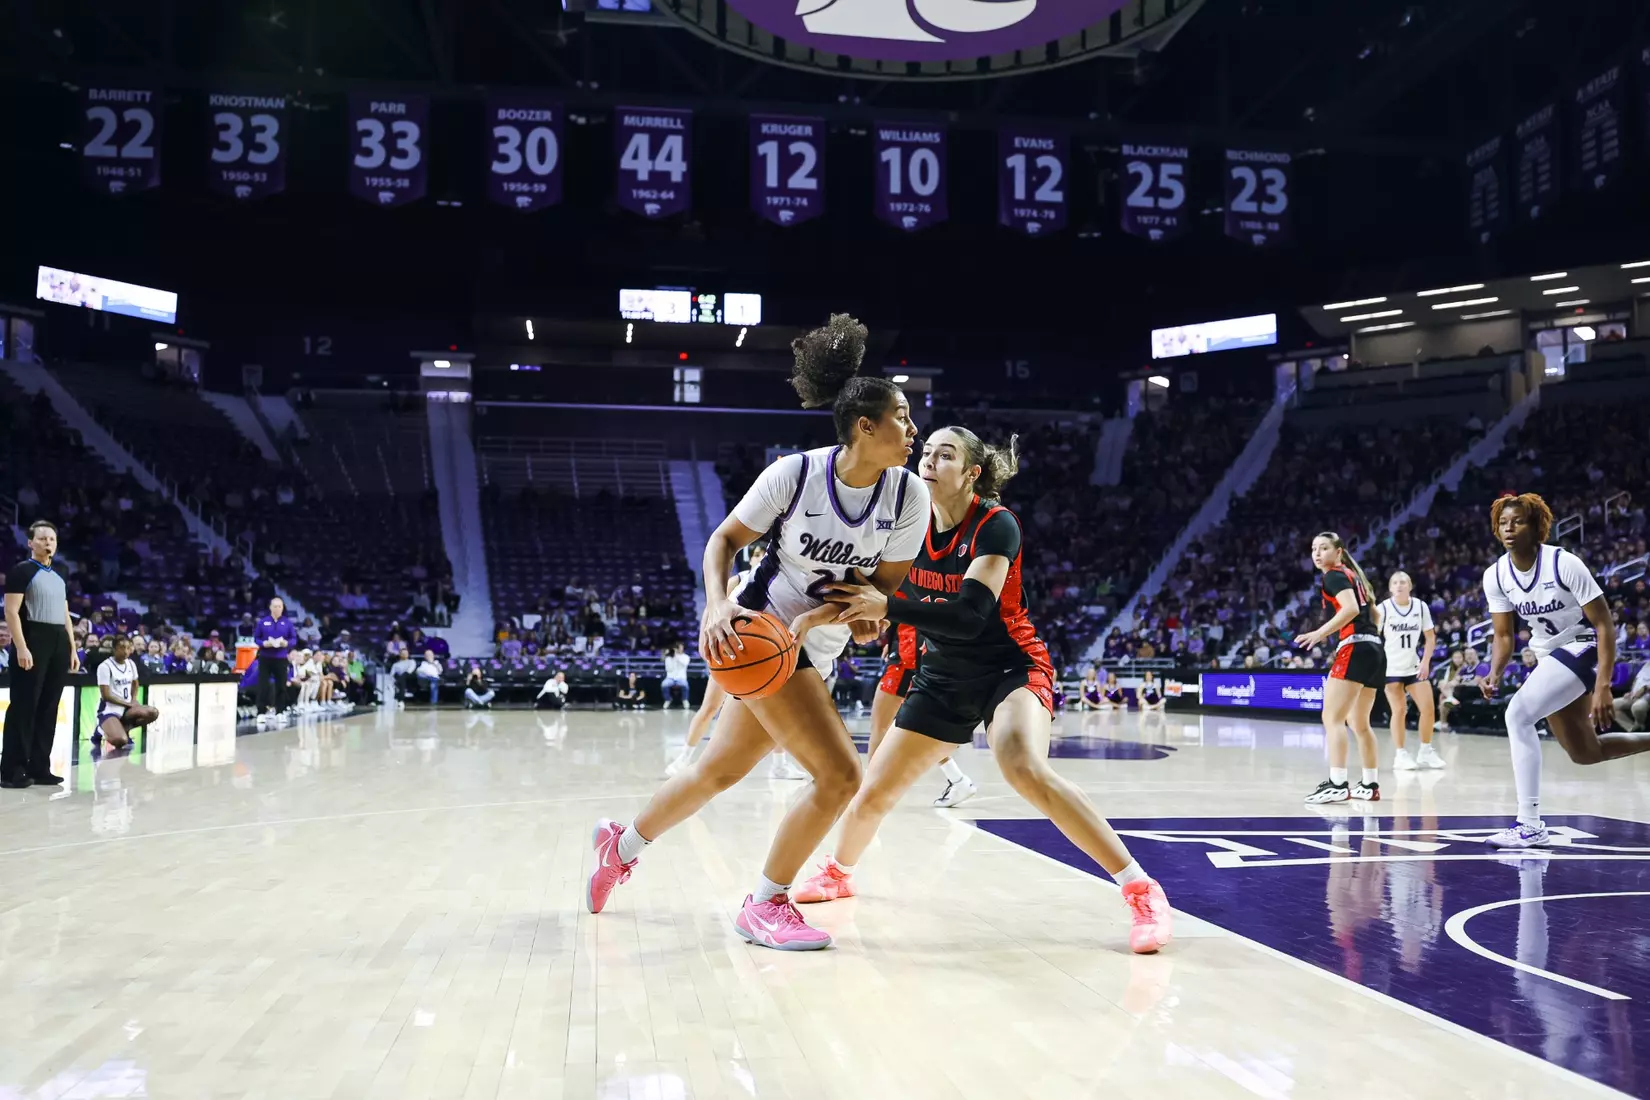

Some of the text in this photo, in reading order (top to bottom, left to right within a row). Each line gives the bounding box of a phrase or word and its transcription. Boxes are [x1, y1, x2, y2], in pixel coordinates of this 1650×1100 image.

[88, 88, 153, 103] BARRETT
[209, 94, 285, 109] KNOSTMAN
[370, 102, 406, 114] PARR
[497, 108, 552, 122] BOOZER
[623, 115, 685, 130] MURRELL
[761, 123, 813, 137] KRUGER
[83, 106, 154, 159] 22
[211, 111, 280, 164] 33
[879, 129, 941, 144] WILLIAMS
[354, 118, 421, 171] 33
[491, 124, 558, 176] 30
[1013, 137, 1055, 150] EVANS
[620, 132, 688, 182] 44
[1122, 144, 1188, 159] BLACKMAN
[1226, 149, 1290, 164] RICHMOND
[757, 140, 817, 189] 12
[880, 146, 940, 196] 10
[1005, 153, 1064, 203] 12
[1126, 160, 1186, 210] 25
[632, 188, 675, 200] 1962-64
[1230, 166, 1288, 216] 23
[766, 196, 808, 207] 1971-74
[889, 202, 931, 213] 1972-76
[302, 335, 333, 355] 12
[876, 519, 894, 530] XII
[800, 533, 883, 568] Wildcat
[918, 569, 943, 592] DIEGO
[1537, 617, 1560, 636] 3
[1400, 634, 1411, 648] 11
